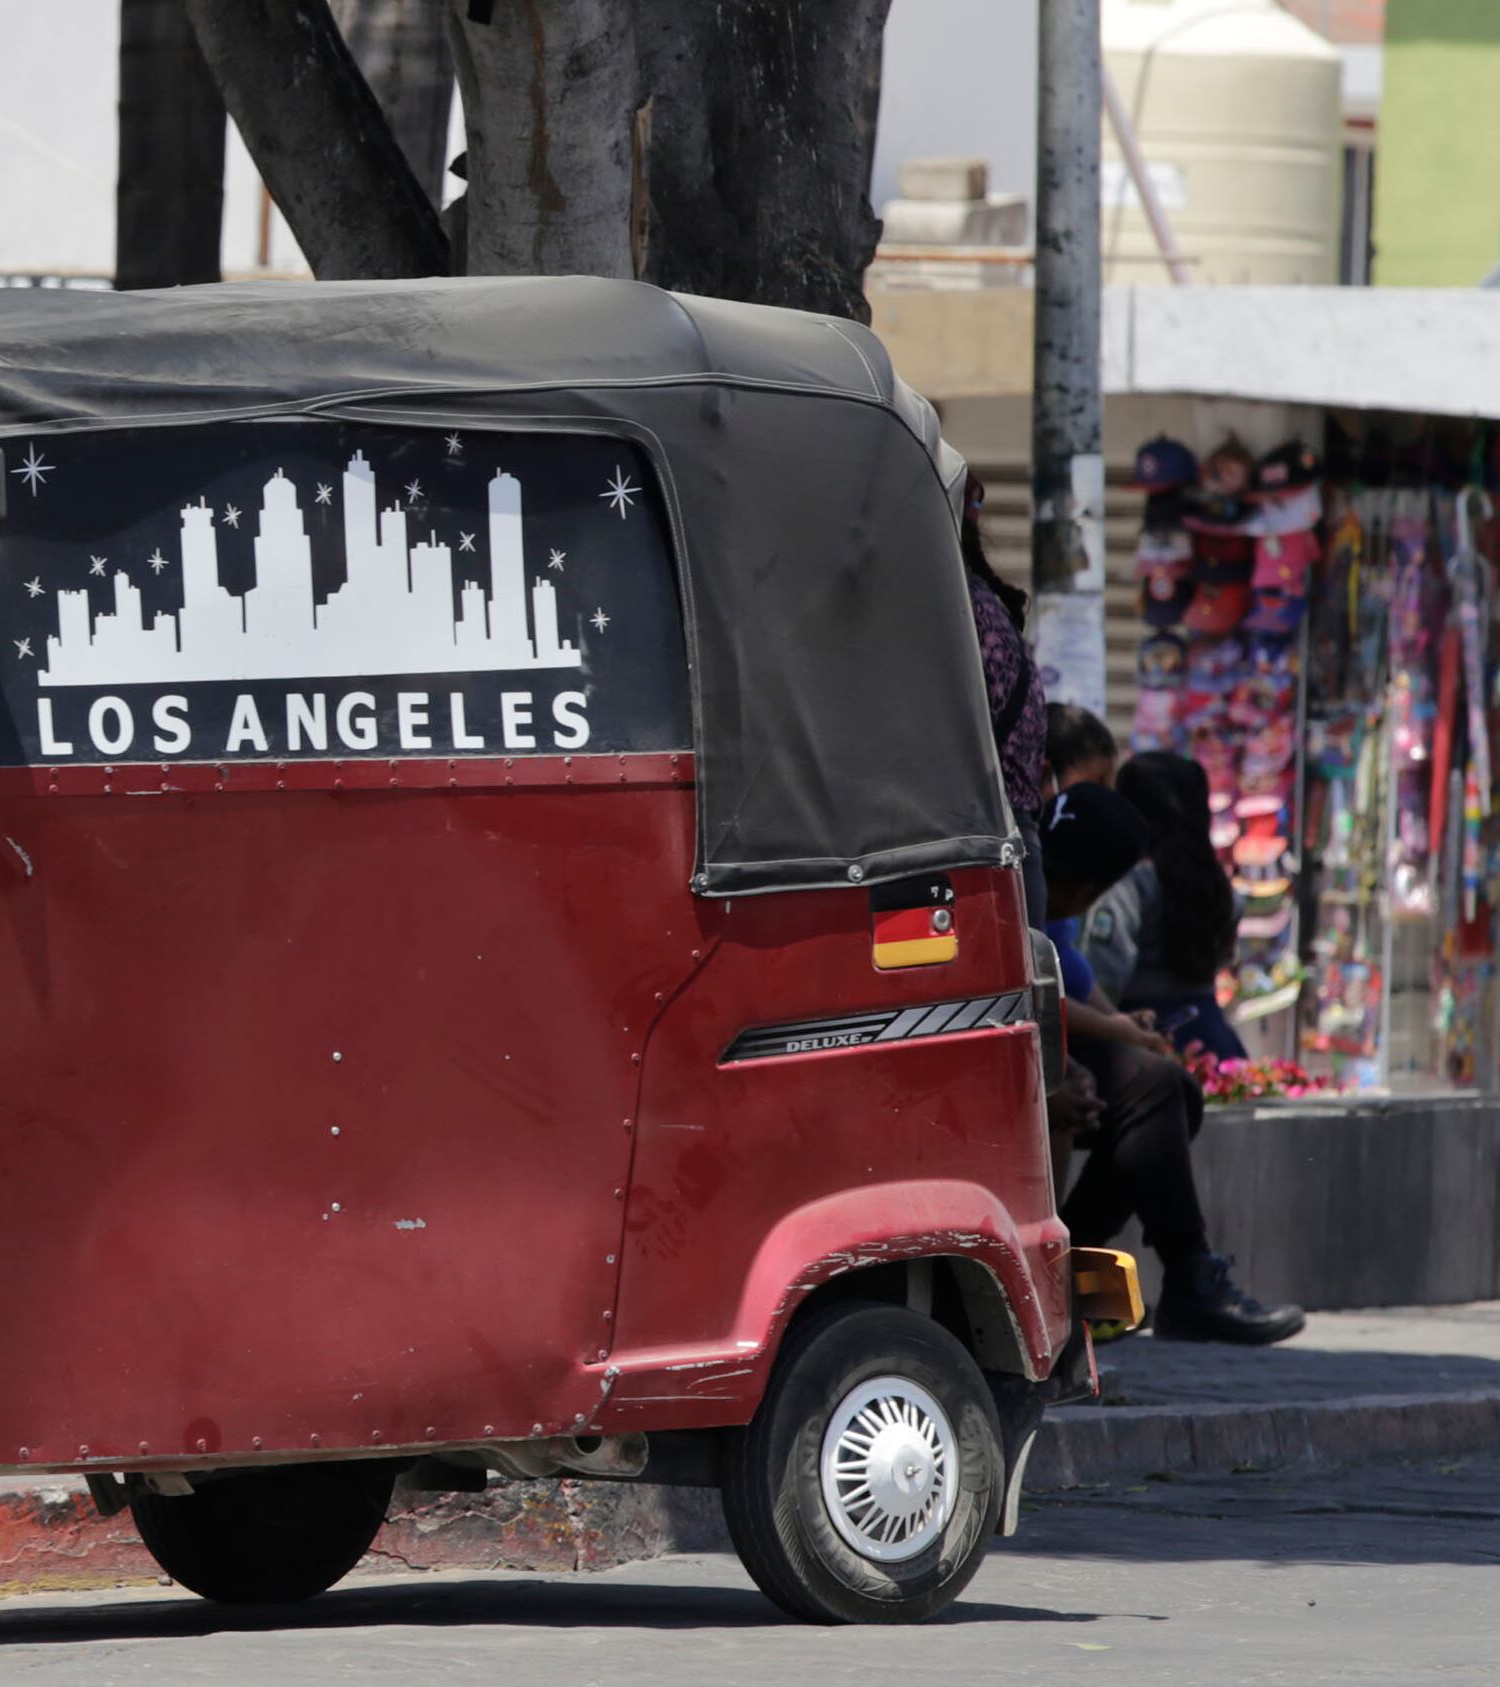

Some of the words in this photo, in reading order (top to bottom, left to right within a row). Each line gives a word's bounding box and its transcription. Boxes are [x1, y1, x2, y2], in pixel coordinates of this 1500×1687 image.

[37, 695, 192, 755] LOS
[225, 690, 591, 753] ANGELES
[786, 1033, 862, 1053] DELUXE
